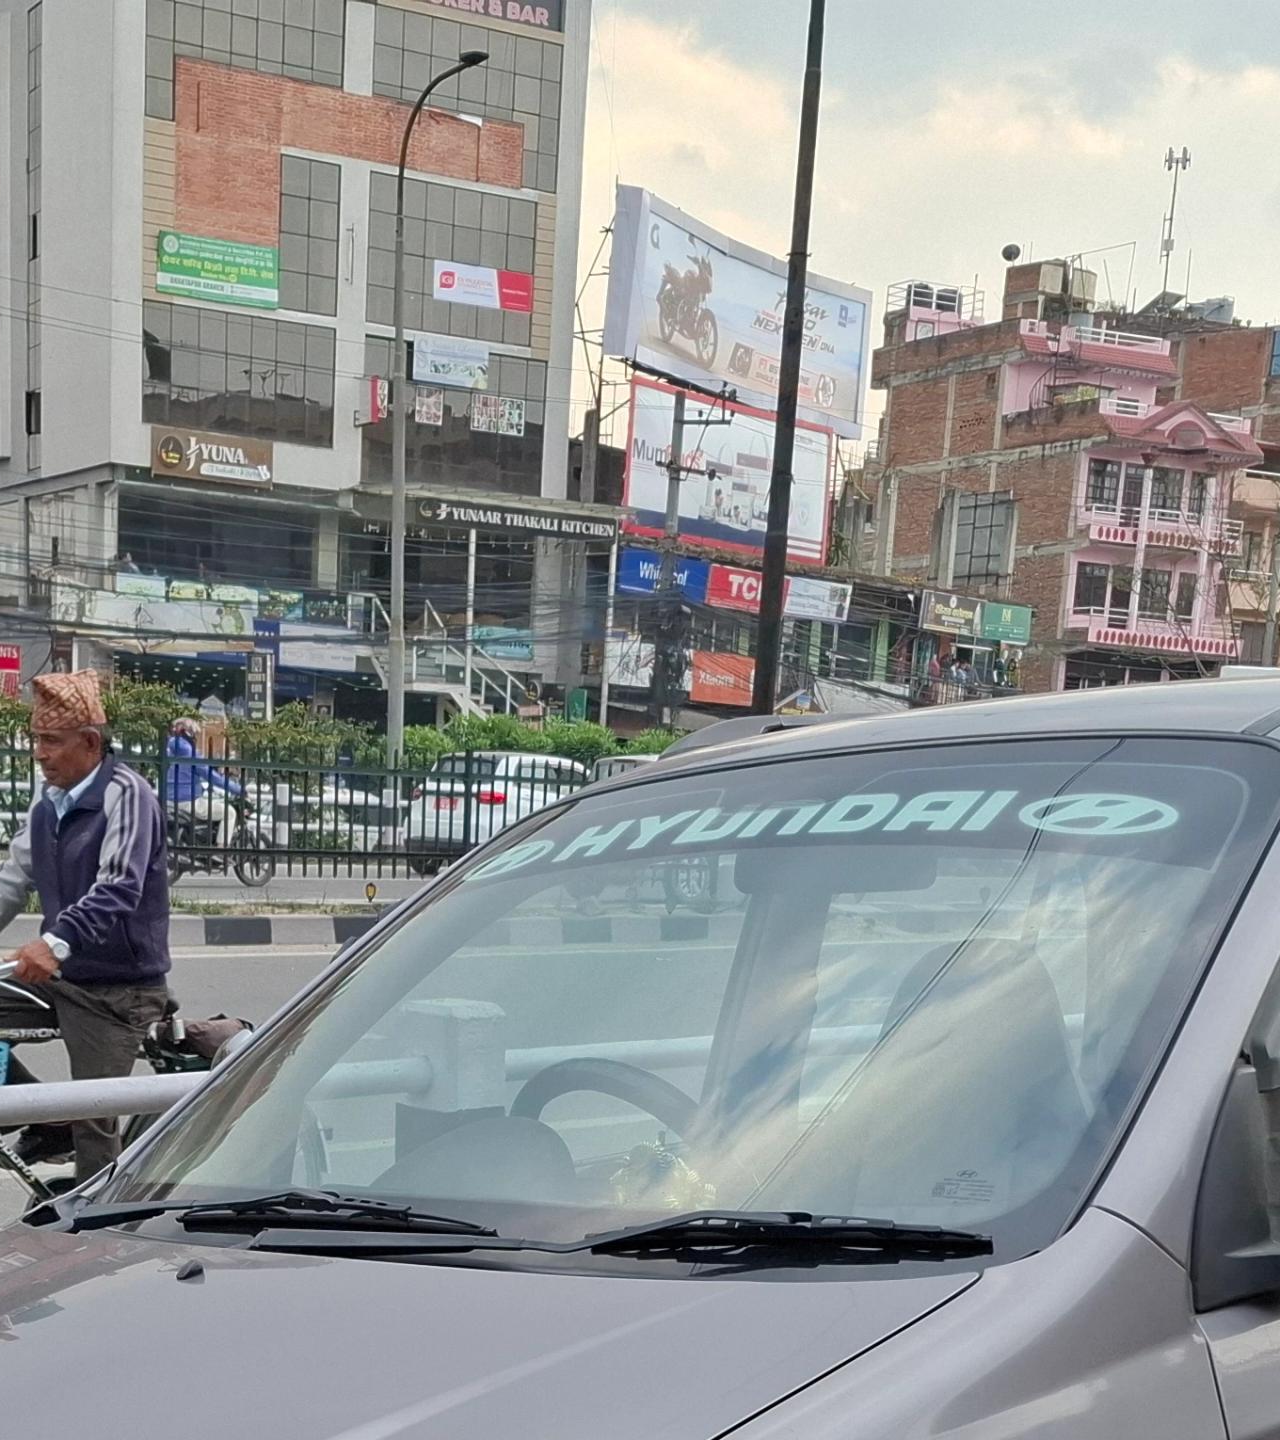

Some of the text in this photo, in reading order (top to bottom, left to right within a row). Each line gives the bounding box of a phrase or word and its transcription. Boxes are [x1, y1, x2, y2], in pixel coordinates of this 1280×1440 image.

[488, 3, 503, 17] &
[506, 2, 549, 26] BAR
[451, 507, 615, 538] YUNAAR THAKALI KITCHEN
[551, 790, 1020, 863] HYUNDAI
